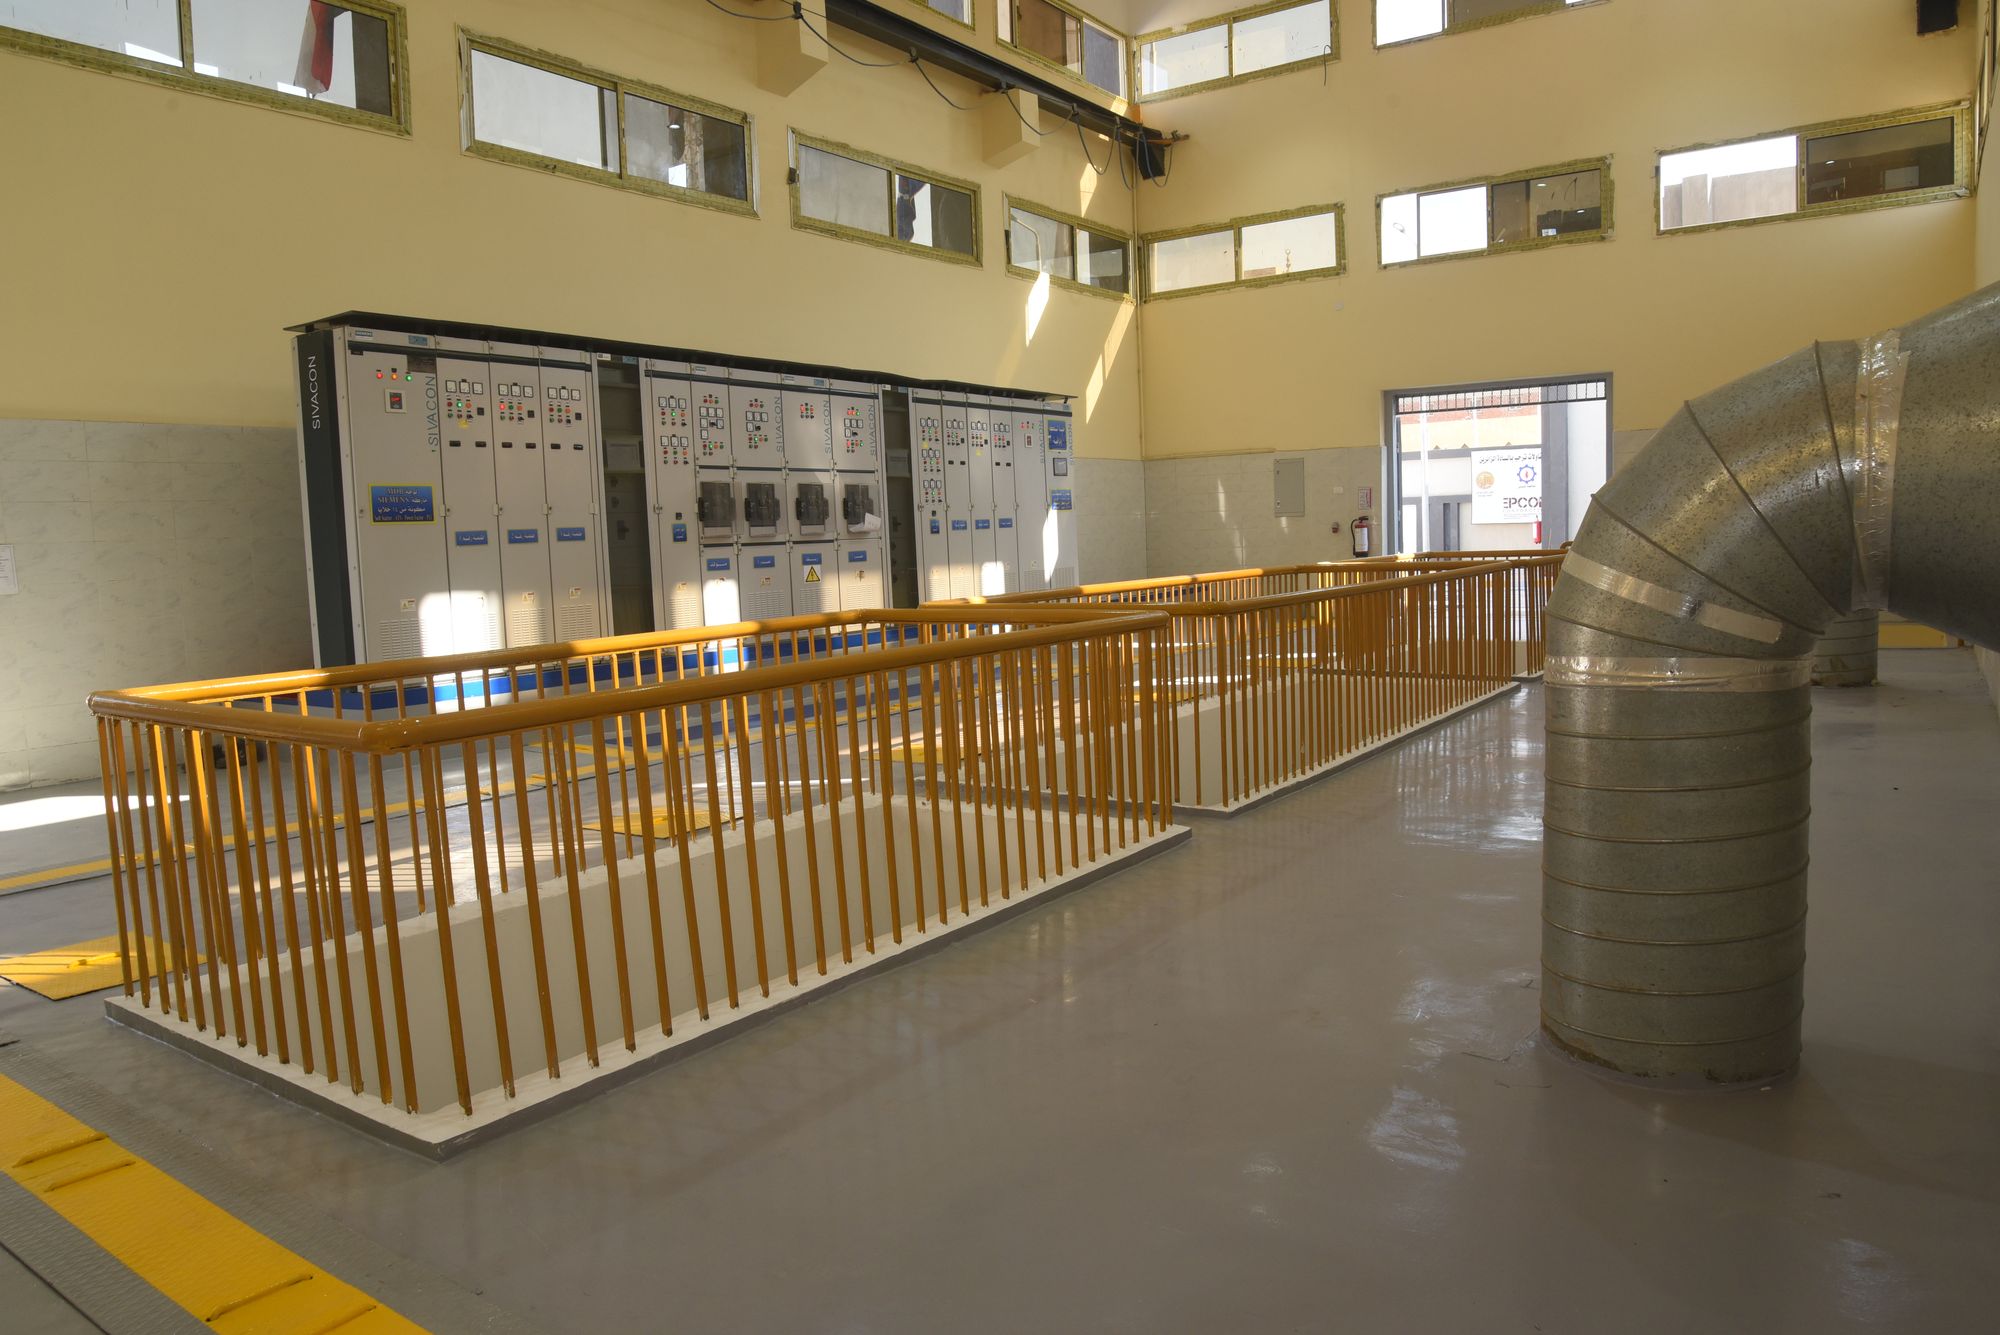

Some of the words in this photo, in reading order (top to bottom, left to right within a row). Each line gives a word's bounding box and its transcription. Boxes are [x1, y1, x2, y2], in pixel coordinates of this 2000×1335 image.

[308, 356, 320, 430] SIVACON
[425, 375, 438, 446] SIVACON
[774, 396, 783, 453] SIVACON
[824, 400, 832, 454] SIVACON
[868, 404, 876, 456] SIVACON
